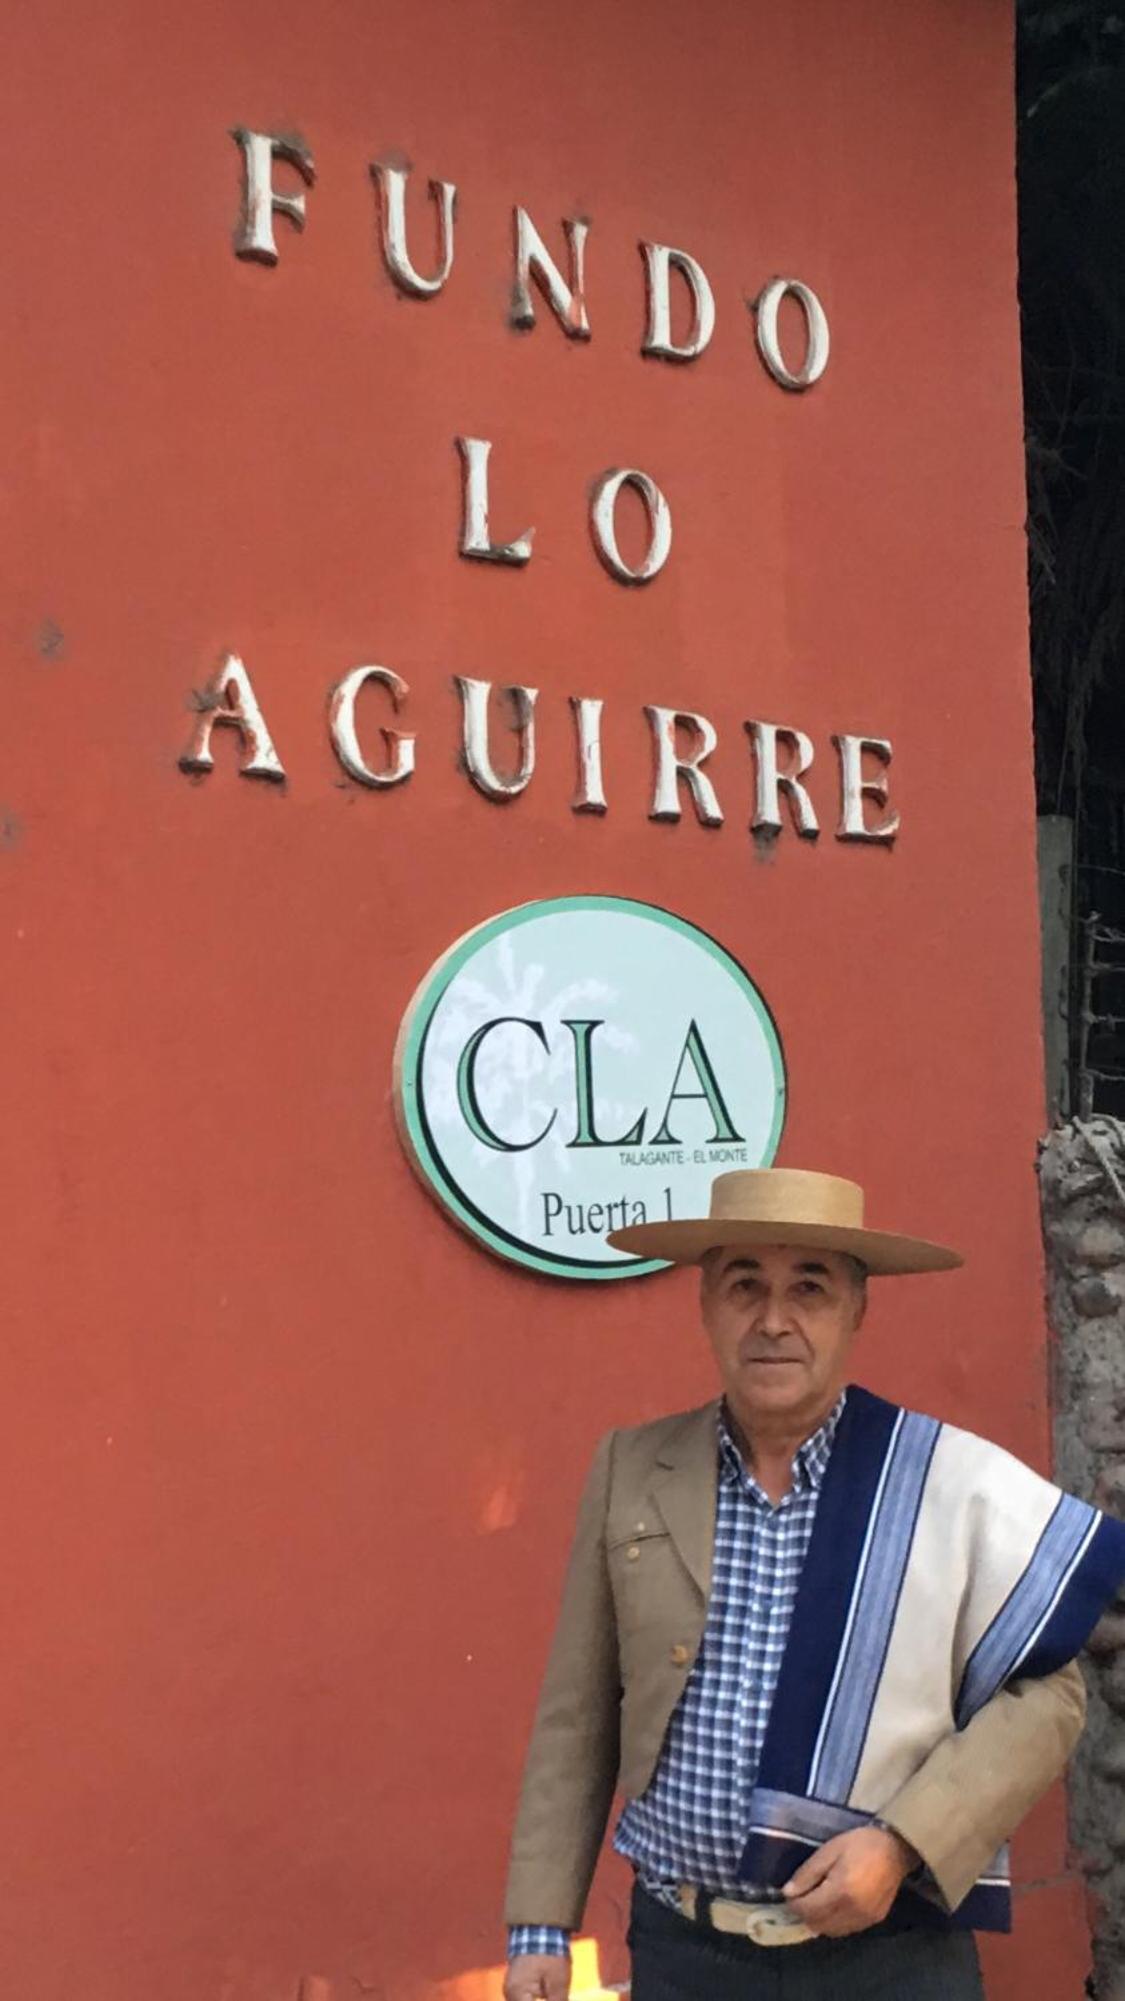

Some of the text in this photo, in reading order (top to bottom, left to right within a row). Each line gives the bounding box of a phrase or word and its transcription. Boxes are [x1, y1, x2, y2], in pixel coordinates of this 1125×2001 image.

[233, 128, 830, 392] FUNDO
[457, 436, 672, 586] LO
[179, 652, 900, 846] AGUIRRE
[456, 1017, 746, 1153] CLA
[540, 1187, 673, 1236] Puerta 1
[619, 1151, 684, 1166] TALAGANTE
[693, 1150, 706, 1164] EL
[708, 1149, 748, 1164] MONTE
